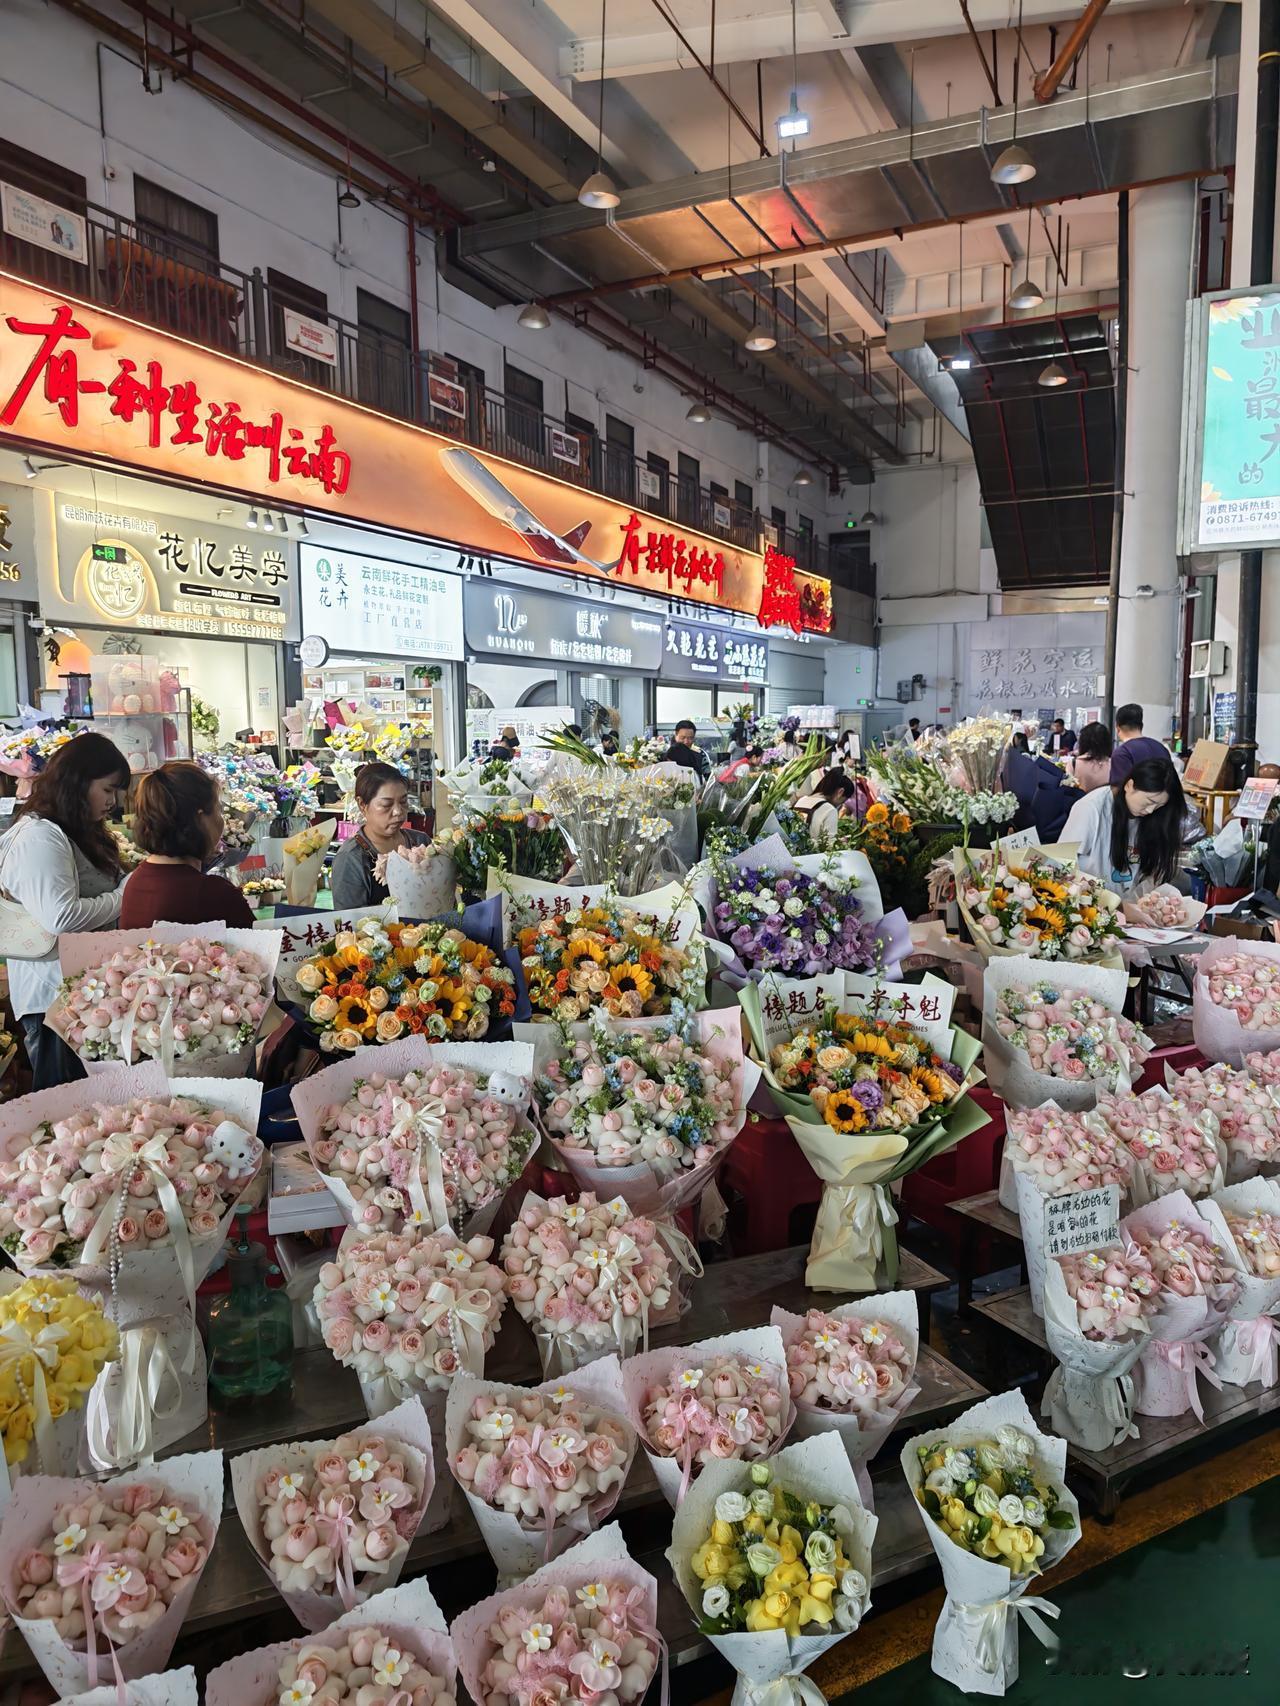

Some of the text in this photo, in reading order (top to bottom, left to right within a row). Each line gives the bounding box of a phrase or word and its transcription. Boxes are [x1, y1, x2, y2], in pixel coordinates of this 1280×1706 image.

[0, 305, 351, 494] 有一种生活叫云南
[1216, 511, 1280, 525] 0871-6749
[158, 533, 289, 586] 花忆美学
[361, 565, 447, 594] 云南鲜花手工精油皂
[980, 648, 1099, 677] 鲜花空运
